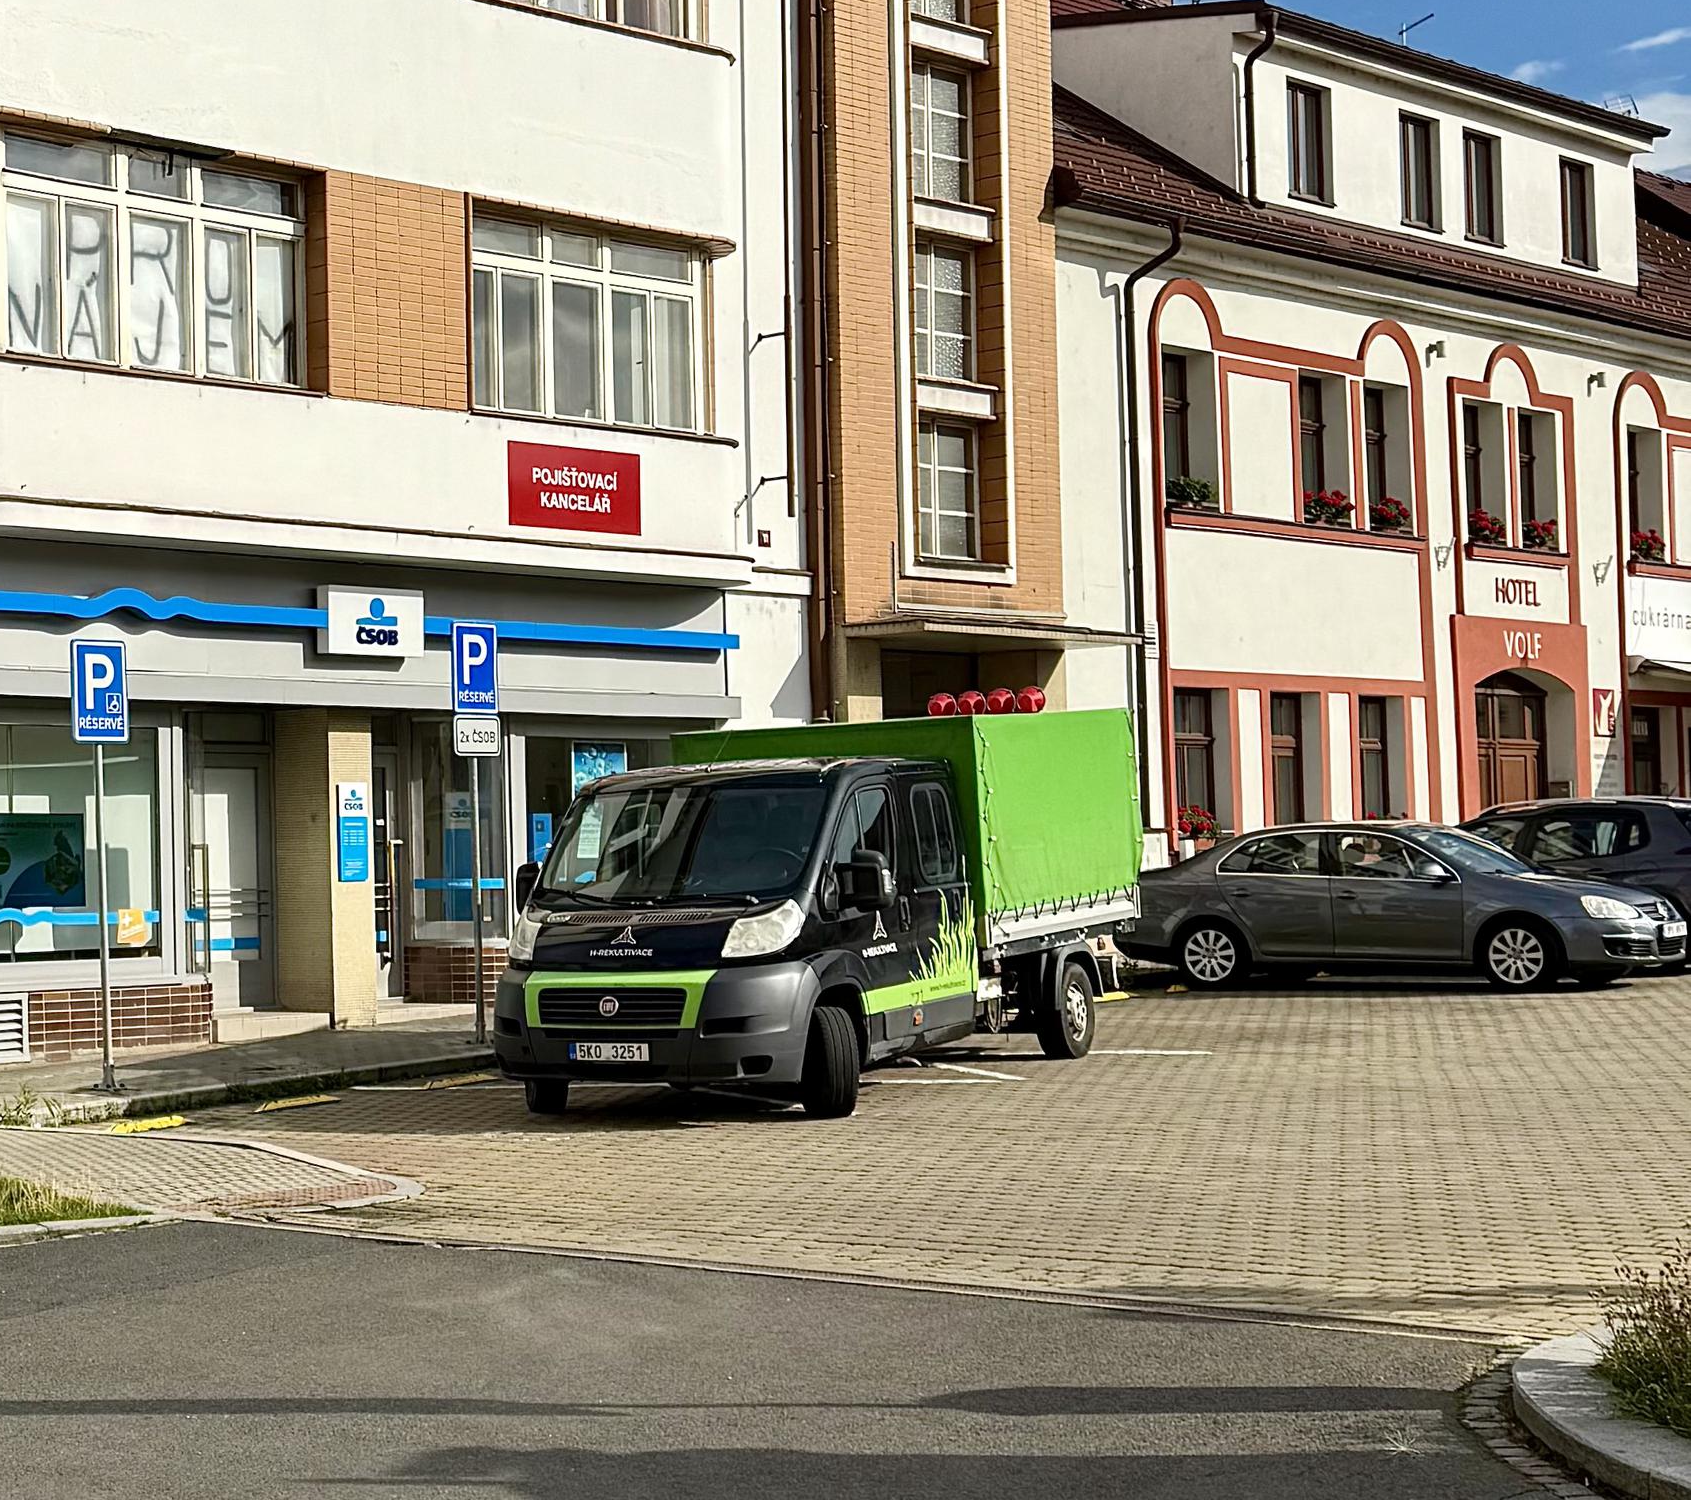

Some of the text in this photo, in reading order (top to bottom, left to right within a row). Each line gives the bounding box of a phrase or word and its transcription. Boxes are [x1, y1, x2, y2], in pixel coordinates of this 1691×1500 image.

[532, 466, 618, 491] POJIŠŤOVACÍ
[540, 491, 611, 514] KANCELÁŘ
[1495, 577, 1541, 607] HOTEL
[1632, 606, 1691, 630] cukrárna
[356, 626, 399, 646] ČSOB
[1503, 630, 1542, 659] VOLF
[462, 633, 488, 685] P
[84, 653, 115, 710] P
[458, 689, 495, 703] RÉSERVÉ
[79, 714, 124, 730] RÉSERVÉ
[460, 728, 496, 744] 2x ČSOB
[611, 1045, 643, 1059] 3251
